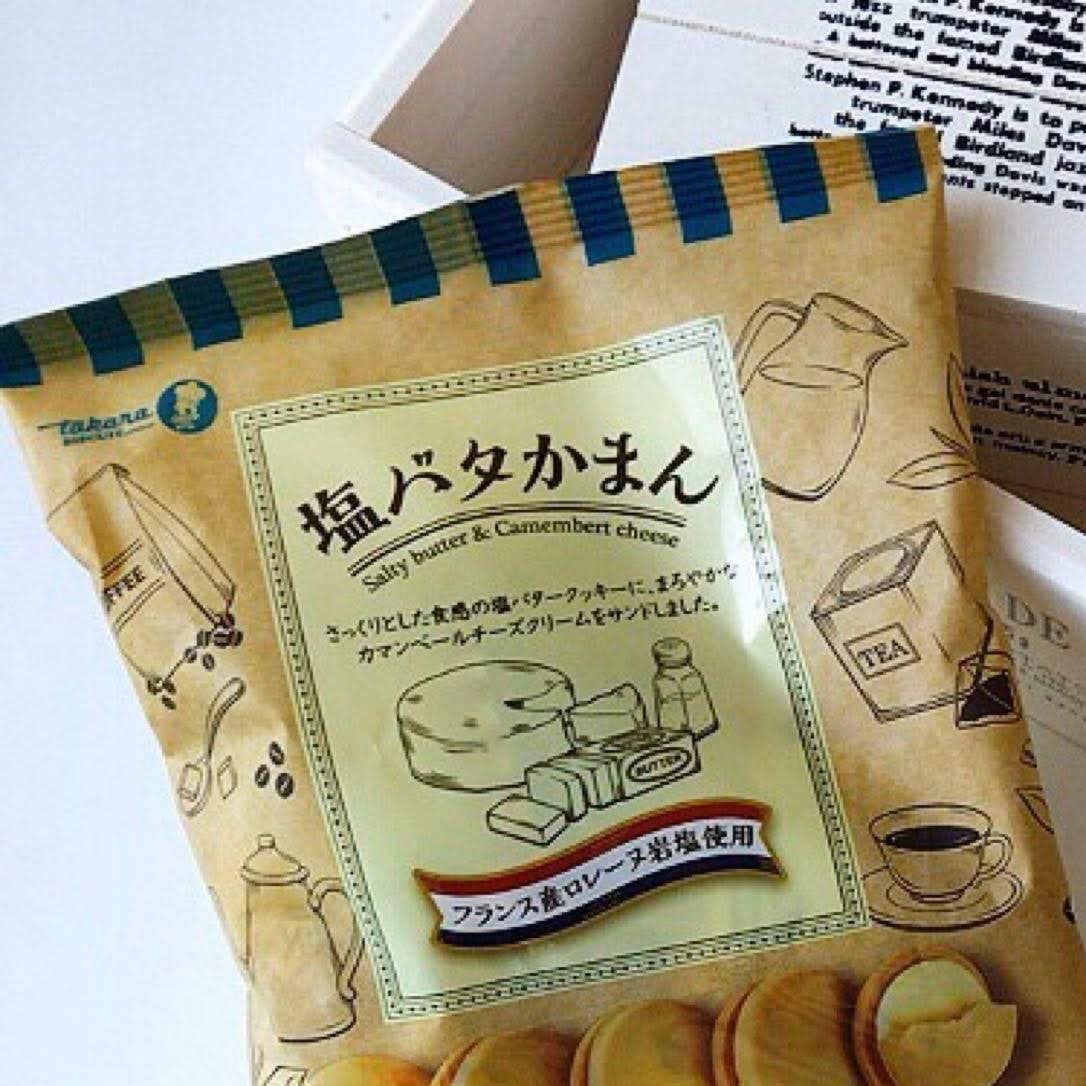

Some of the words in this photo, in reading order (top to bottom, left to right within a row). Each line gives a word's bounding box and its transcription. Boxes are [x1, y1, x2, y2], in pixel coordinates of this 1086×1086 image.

[893, 22, 926, 42] the
[804, 62, 882, 93] Stephen
[911, 85, 1005, 120] Kennedy
[1040, 111, 1064, 129] to
[850, 94, 954, 126] trumpeter
[969, 116, 1027, 143] Miles
[834, 111, 867, 131] the
[954, 133, 1047, 166] Birdland
[995, 164, 1048, 187] Davis
[297, 431, 720, 556] 塩バタかまん
[361, 557, 410, 594] Salty
[410, 532, 468, 567] butter
[471, 524, 491, 543] &
[493, 516, 612, 540] Camembert
[615, 519, 681, 548] cheese
[1005, 592, 1071, 650] DE
[856, 637, 911, 669] TEA
[452, 822, 756, 928] フランス産ロレーヌ岩塩使用
